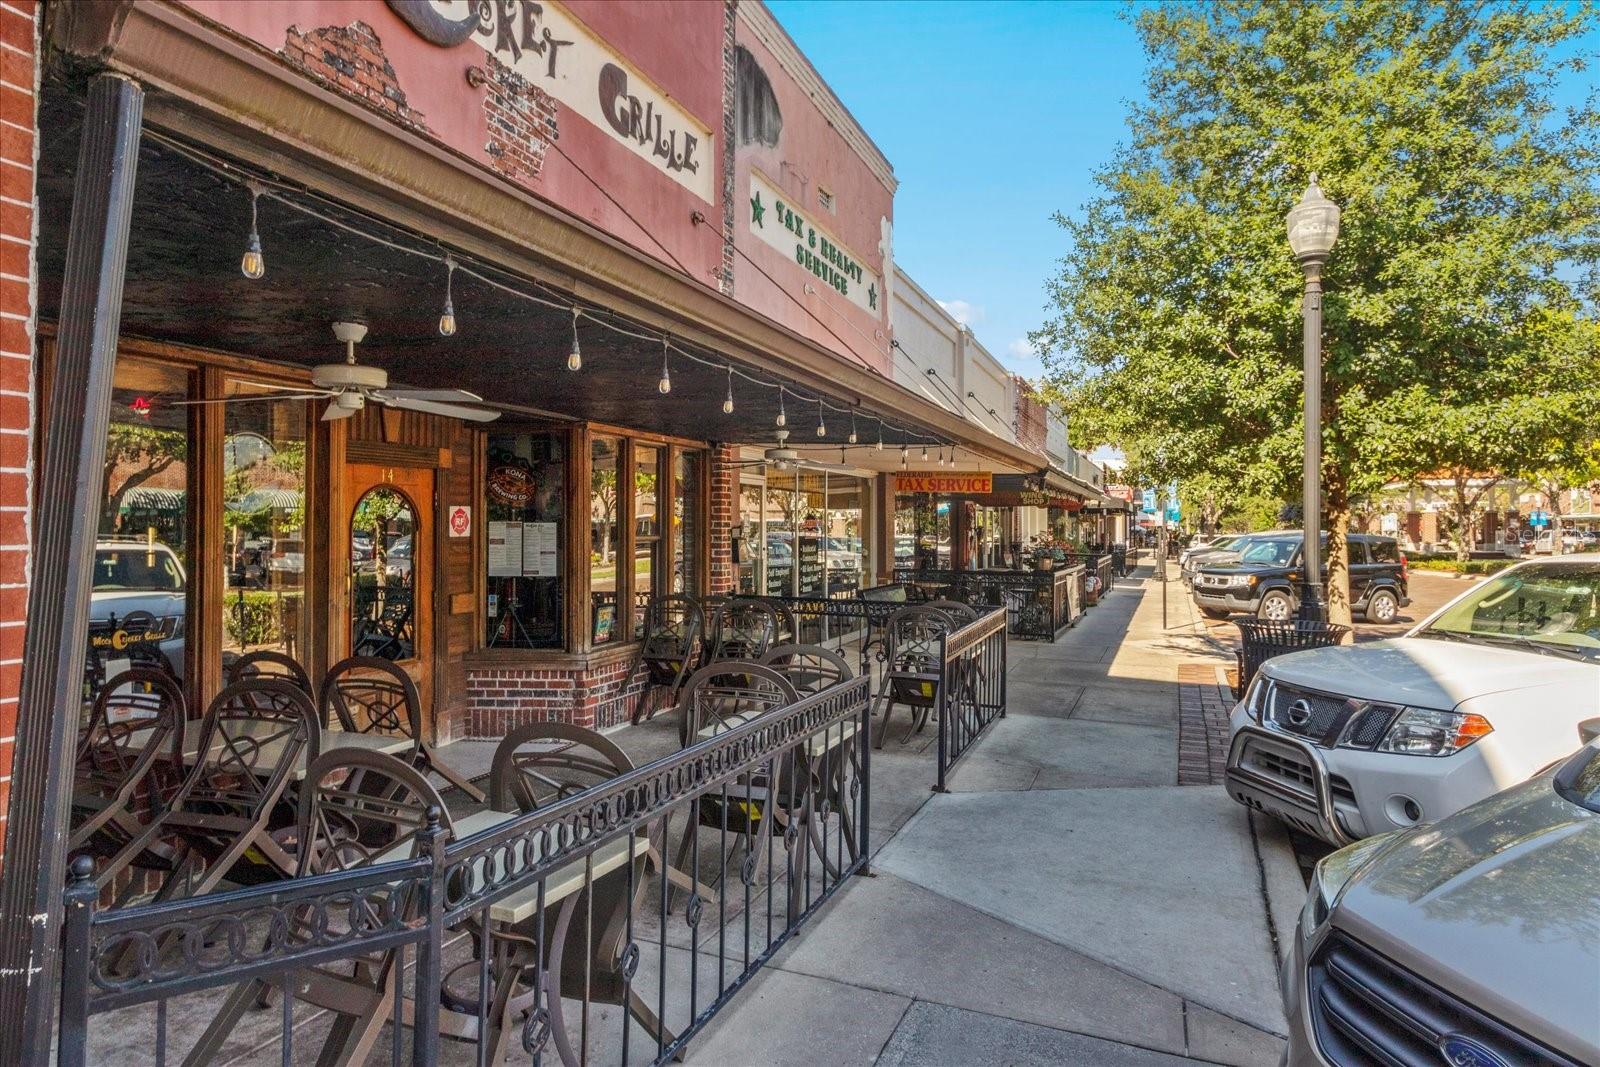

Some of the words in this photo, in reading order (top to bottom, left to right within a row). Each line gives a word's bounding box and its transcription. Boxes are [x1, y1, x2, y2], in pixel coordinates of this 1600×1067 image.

[598, 62, 699, 176] GRILLE
[775, 200, 804, 239] TAX
[808, 228, 816, 248] &
[820, 236, 863, 285] REALTY
[796, 243, 848, 296] SERVICE
[491, 482, 518, 500] BREWING
[505, 468, 526, 481] KONA
[896, 479, 924, 491] TAX
[927, 478, 991, 491] SERVICE
